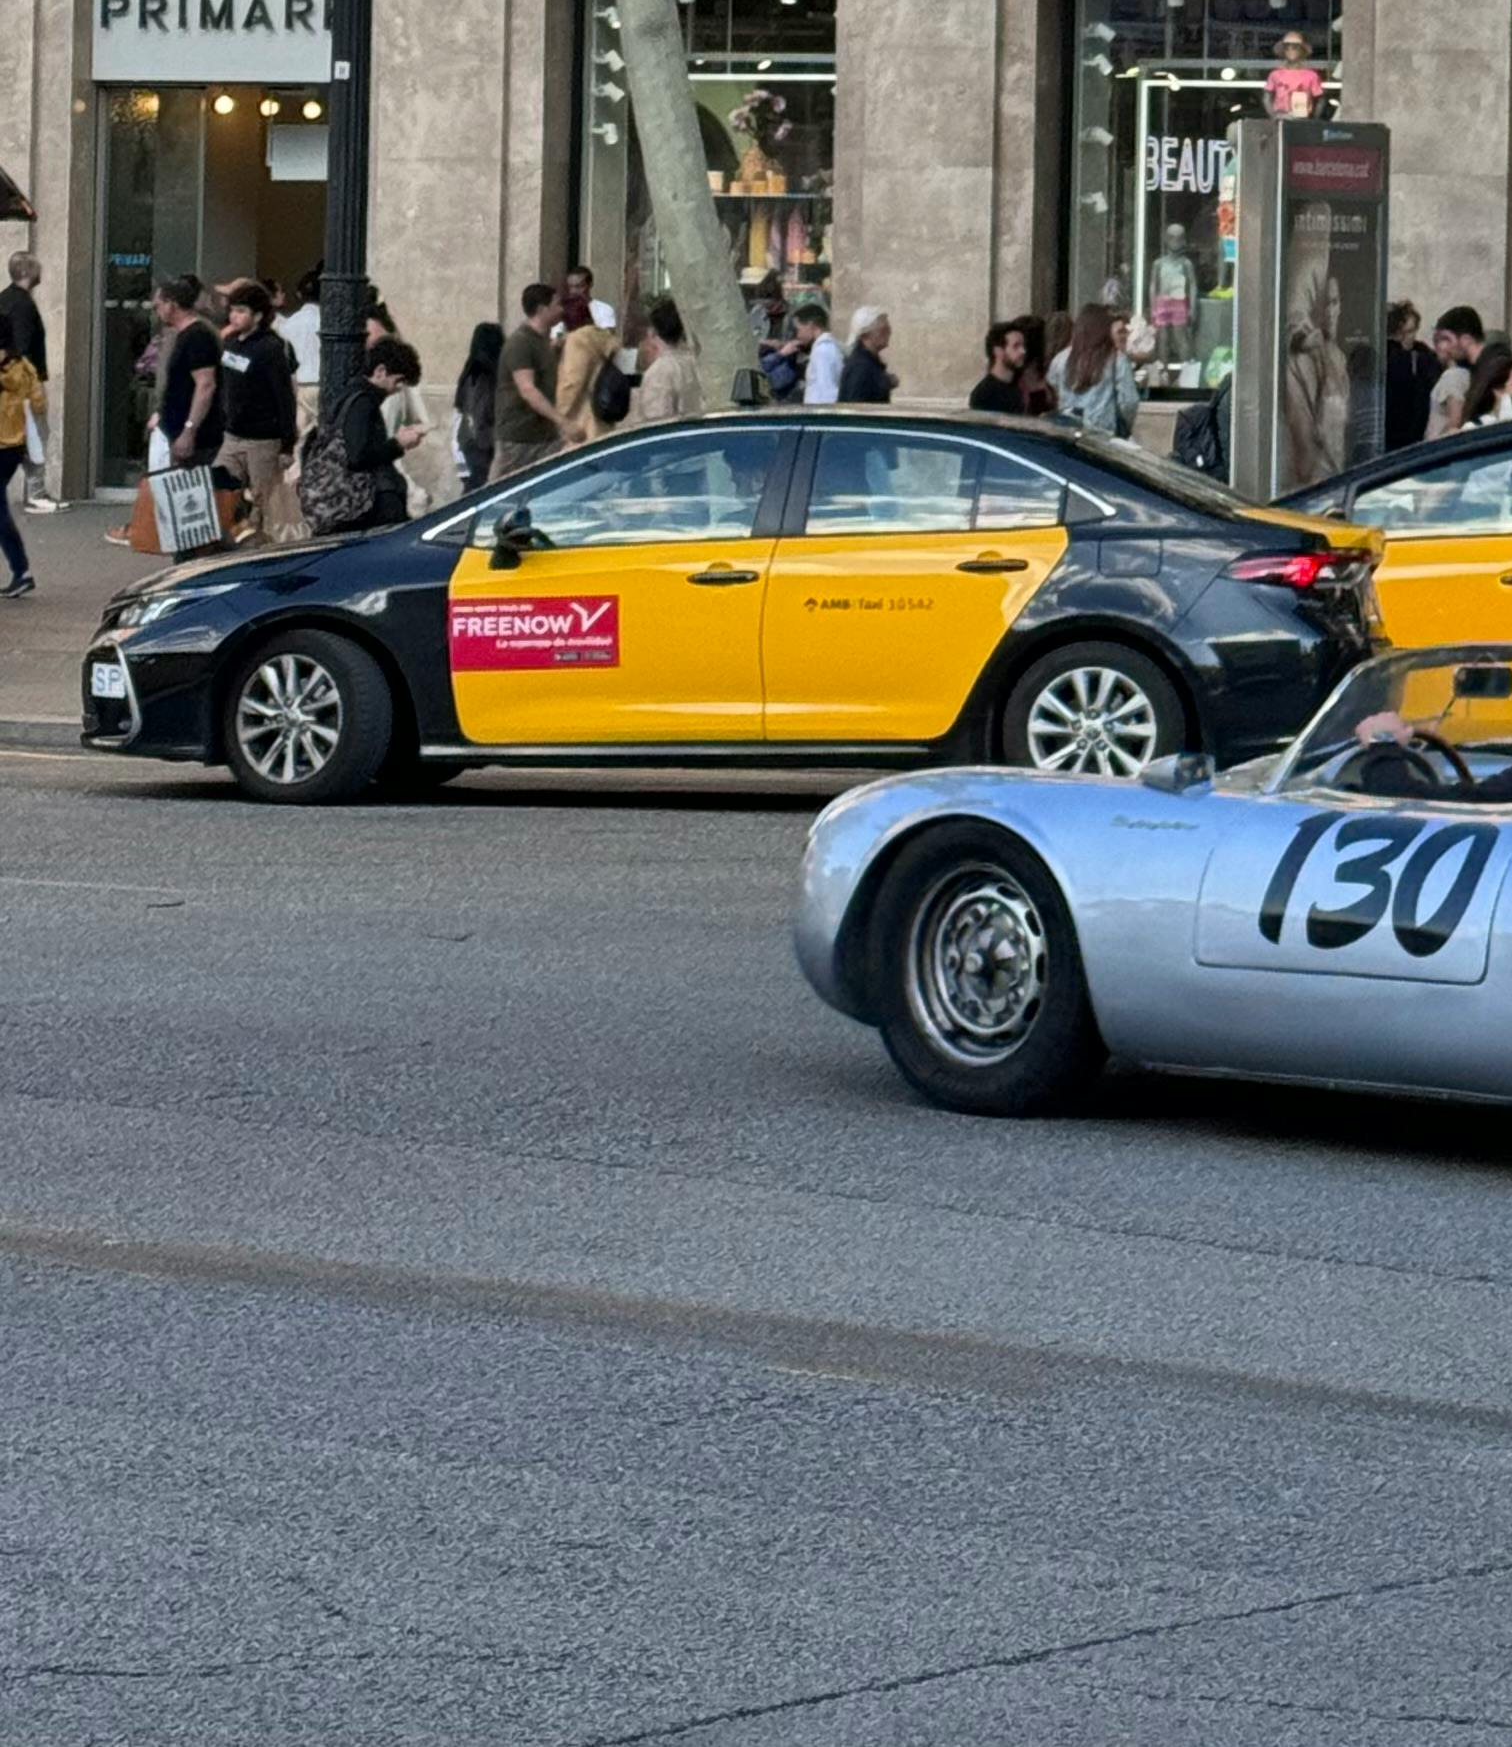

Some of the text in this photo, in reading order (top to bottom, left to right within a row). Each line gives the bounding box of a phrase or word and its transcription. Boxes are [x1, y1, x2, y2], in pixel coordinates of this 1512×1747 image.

[1146, 136, 1238, 194] BEAUT
[452, 615, 573, 637] FREENOW
[95, 667, 120, 692] SP
[1258, 811, 1500, 957] 130
